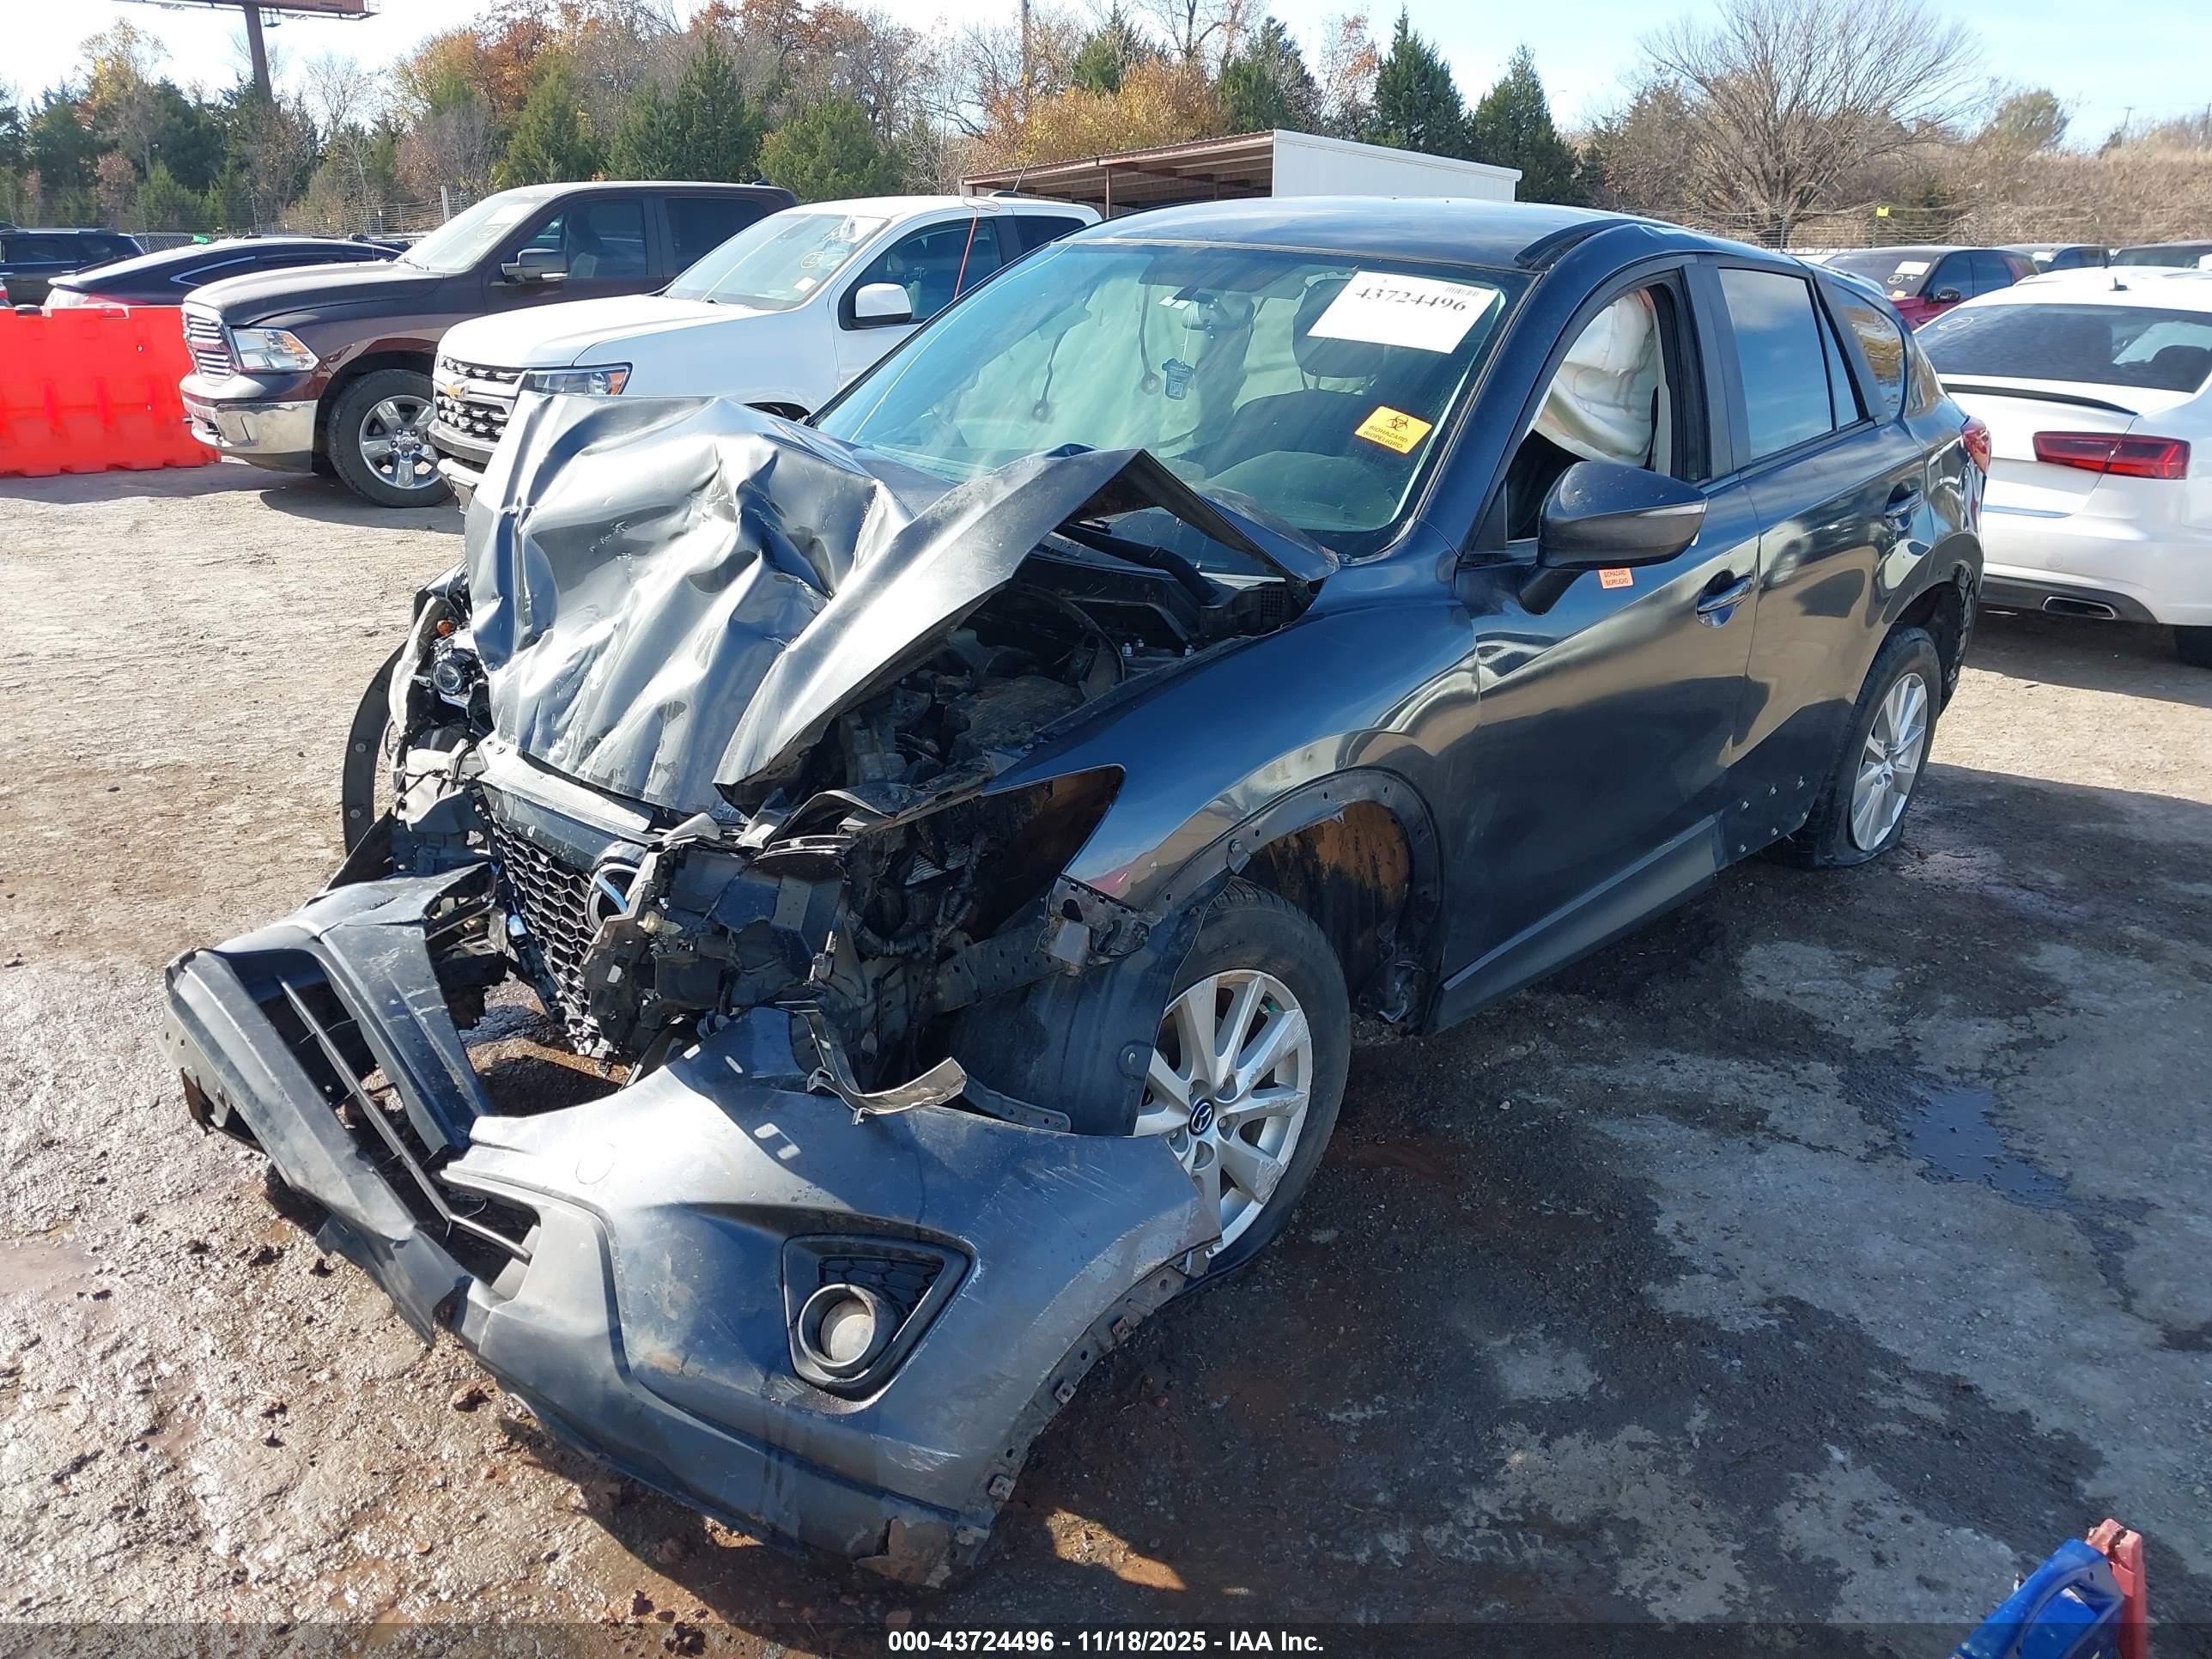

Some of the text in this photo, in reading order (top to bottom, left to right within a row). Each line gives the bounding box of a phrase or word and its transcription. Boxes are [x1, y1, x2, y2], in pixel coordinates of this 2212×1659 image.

[1356, 287, 1466, 312] 43724496
[1363, 431, 1403, 449] BIOPELIGRO
[1369, 425, 1408, 443] BIOHAZARD
